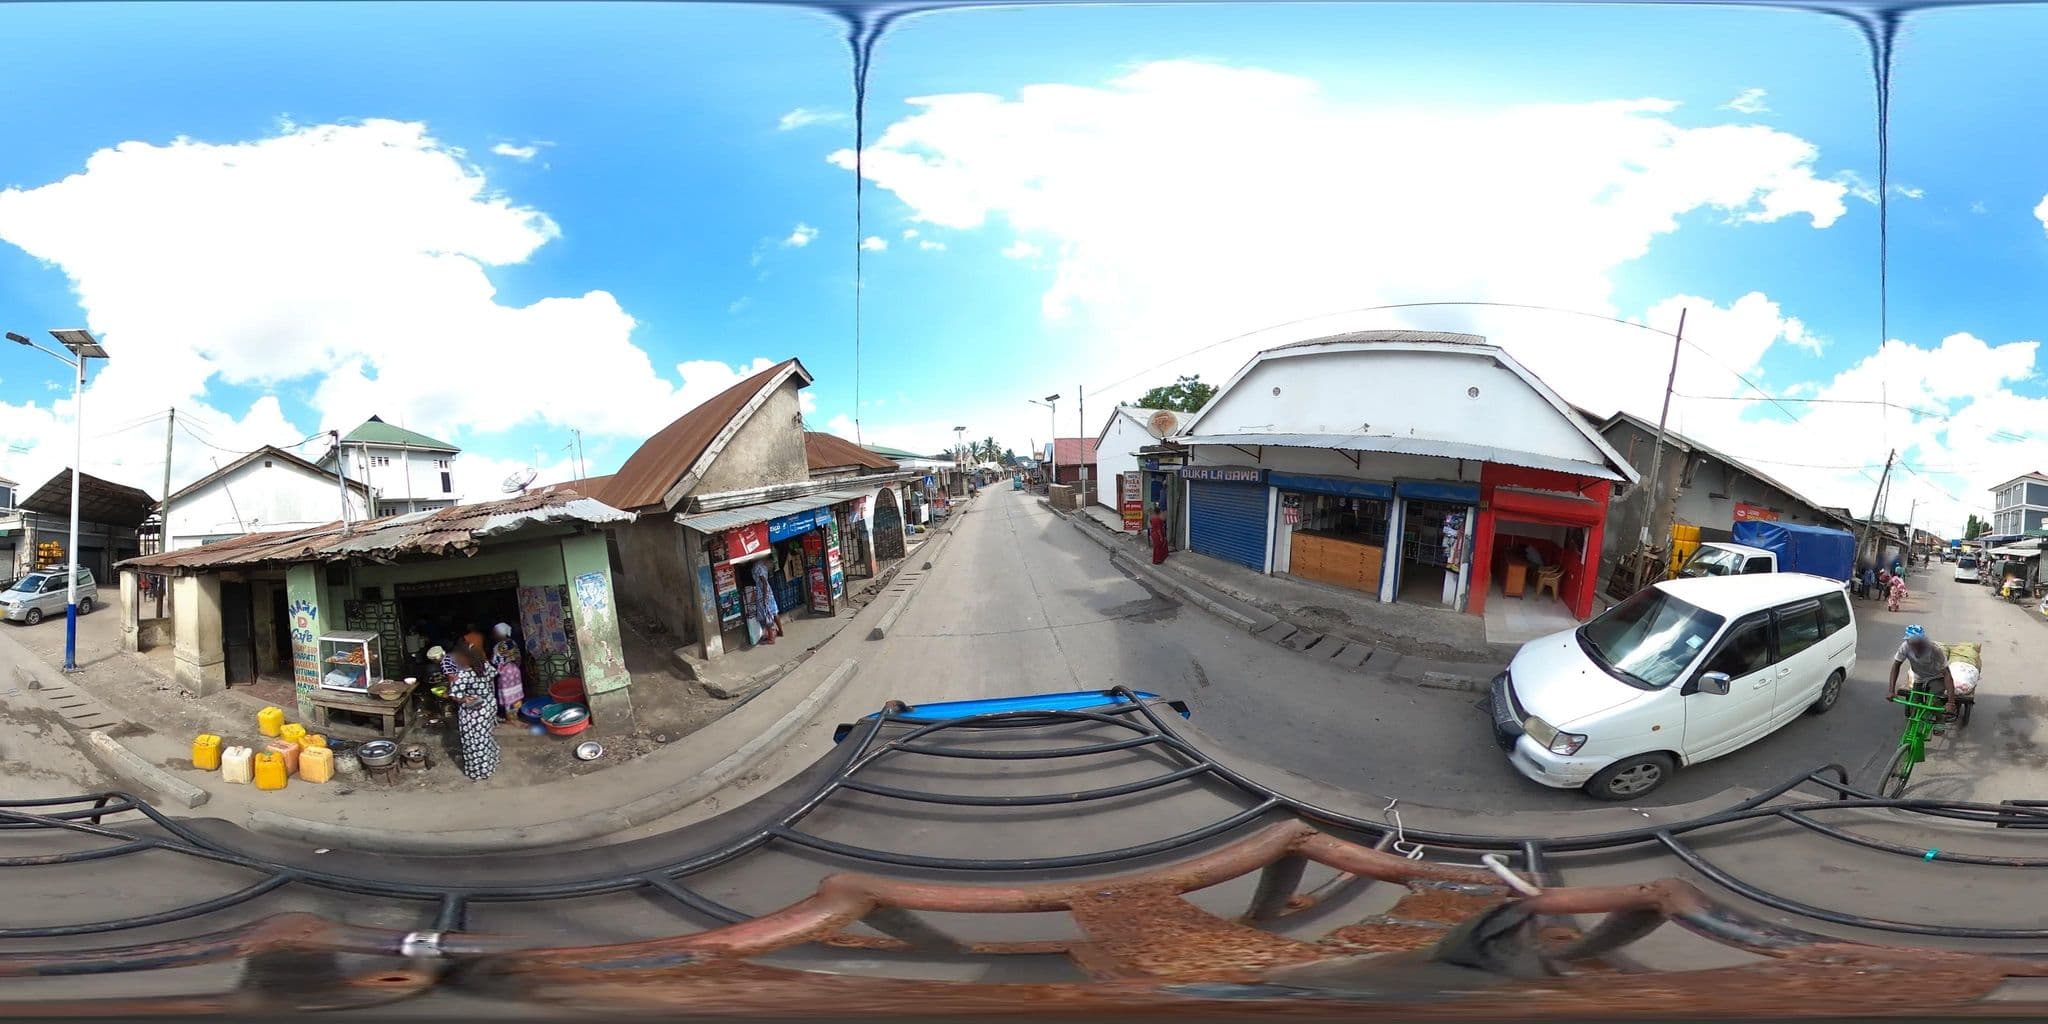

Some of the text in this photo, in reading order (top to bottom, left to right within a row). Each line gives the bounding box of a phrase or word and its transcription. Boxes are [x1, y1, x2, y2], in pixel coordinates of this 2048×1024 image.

[1182, 469, 1208, 479] DUKA
[1210, 470, 1223, 480] LA
[289, 599, 317, 620] MAMA
